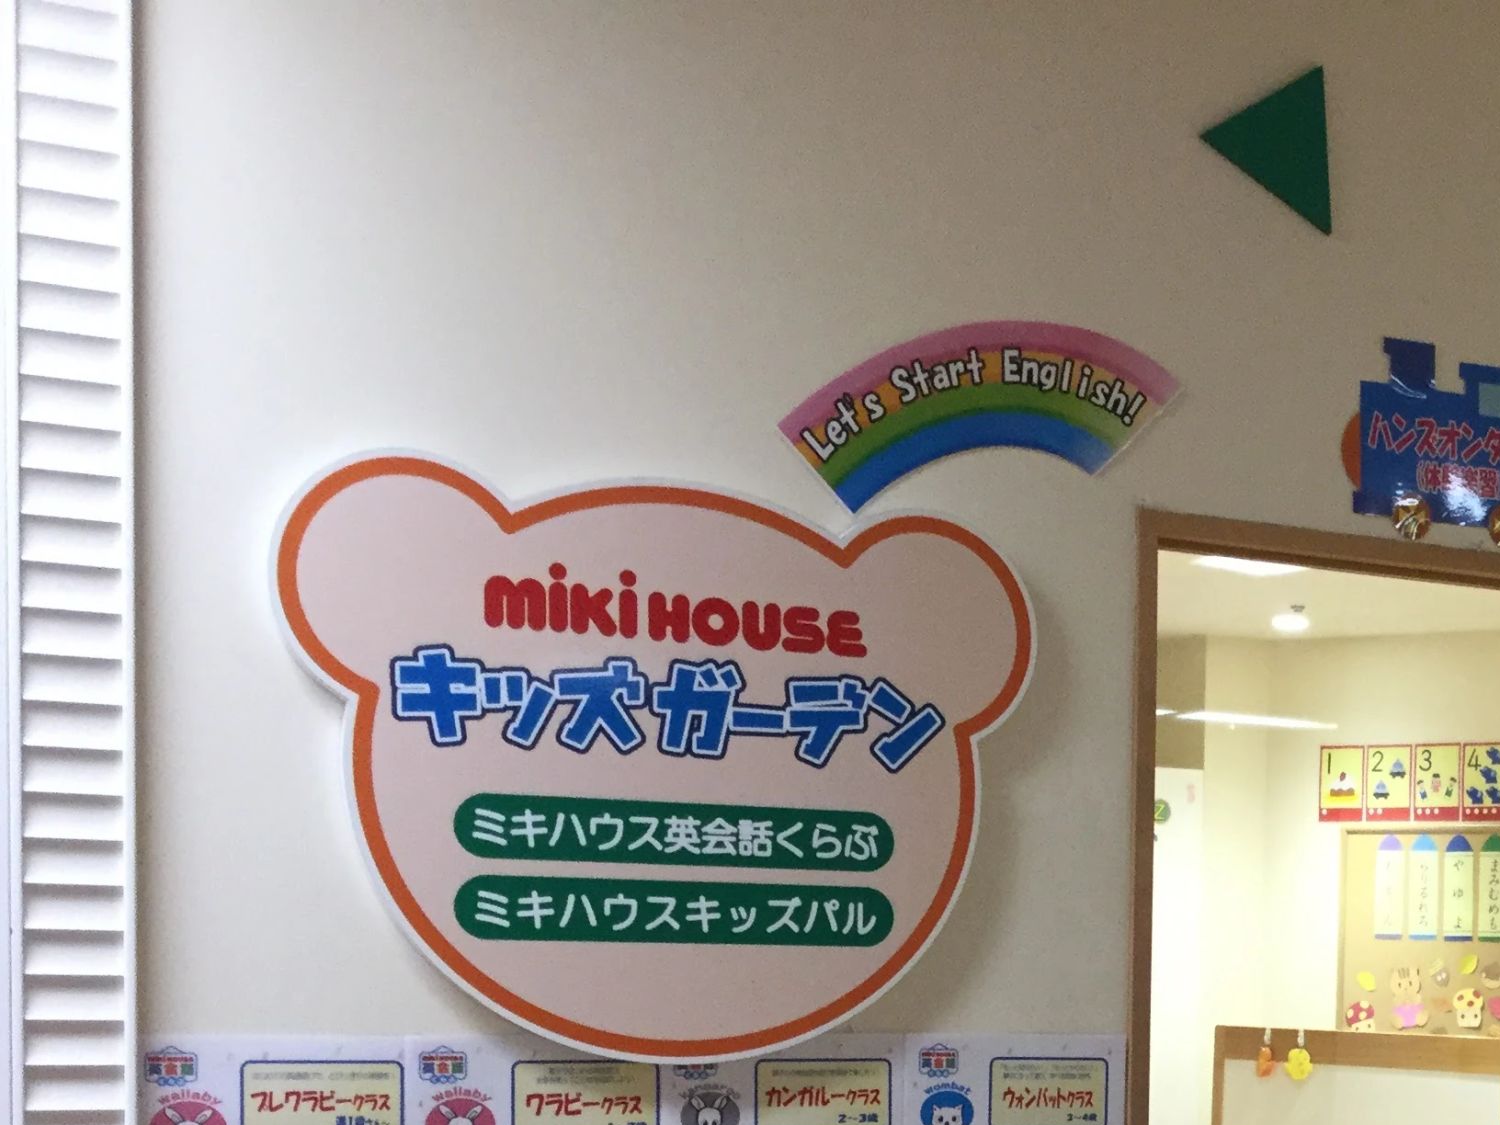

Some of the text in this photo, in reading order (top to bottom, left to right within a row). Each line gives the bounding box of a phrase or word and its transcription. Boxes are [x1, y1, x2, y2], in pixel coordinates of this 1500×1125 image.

[800, 346, 1146, 463] Let's Start English!
[391, 644, 945, 774] キッズガーデン
[1371, 751, 1384, 772] 2
[1419, 749, 1432, 771] 3
[1467, 748, 1481, 771] 4
[473, 807, 879, 862] ミキハウス英会話くらぶ
[1487, 859, 1500, 930] まみむめも
[473, 888, 876, 936] ミキハウスキッズパル
[766, 1087, 881, 1107] カンガルークラス
[924, 1082, 972, 1096] wombat
[1003, 1087, 1094, 1109] ウォンバットクラス
[251, 1091, 391, 1112] プレワラビークラス
[526, 1093, 643, 1116] ワラビークラス
